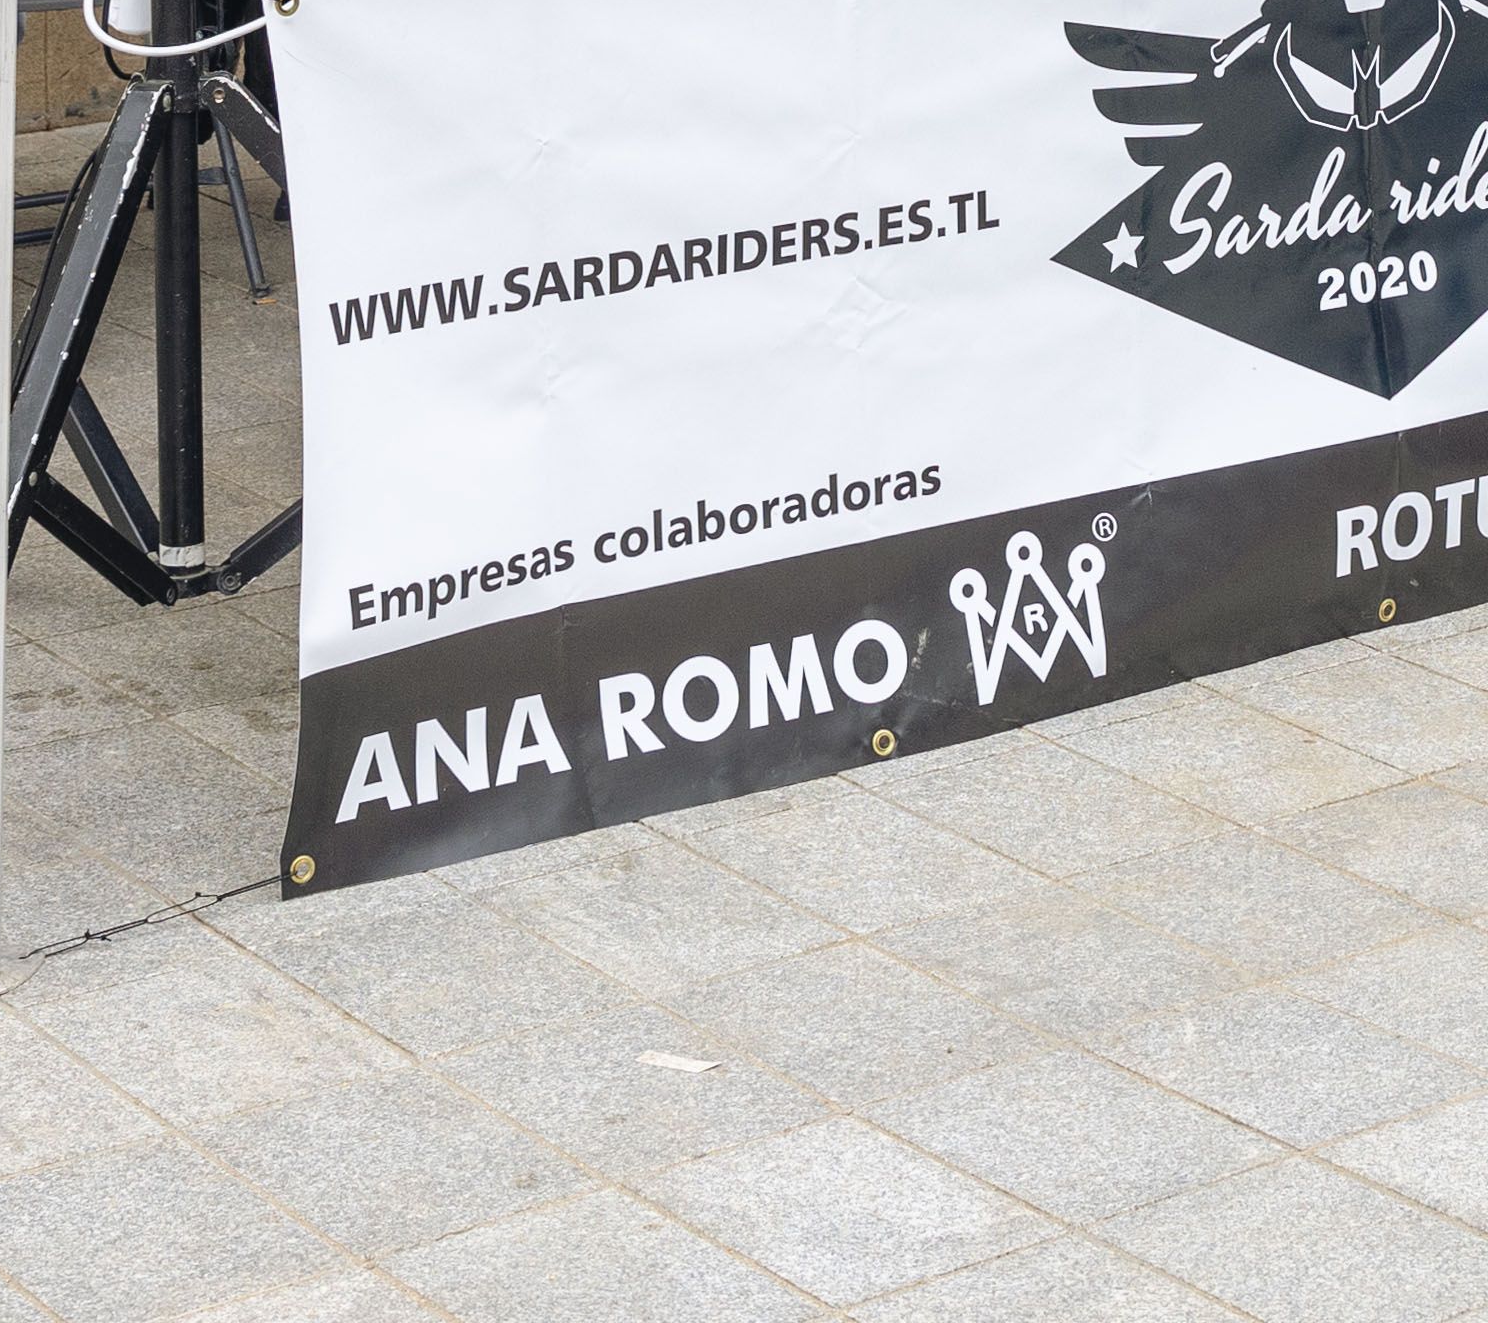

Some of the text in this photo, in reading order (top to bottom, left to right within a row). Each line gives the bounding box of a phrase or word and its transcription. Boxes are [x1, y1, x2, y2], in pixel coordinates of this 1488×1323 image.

[329, 189, 1000, 345] WWW.SARDARIDERS.ES.TL
[1163, 146, 1373, 275] Sarda
[1318, 250, 1438, 311] 2020
[348, 465, 942, 631] Empresas colaboradoras
[335, 694, 572, 824] ANA
[598, 619, 908, 762] ROMO
